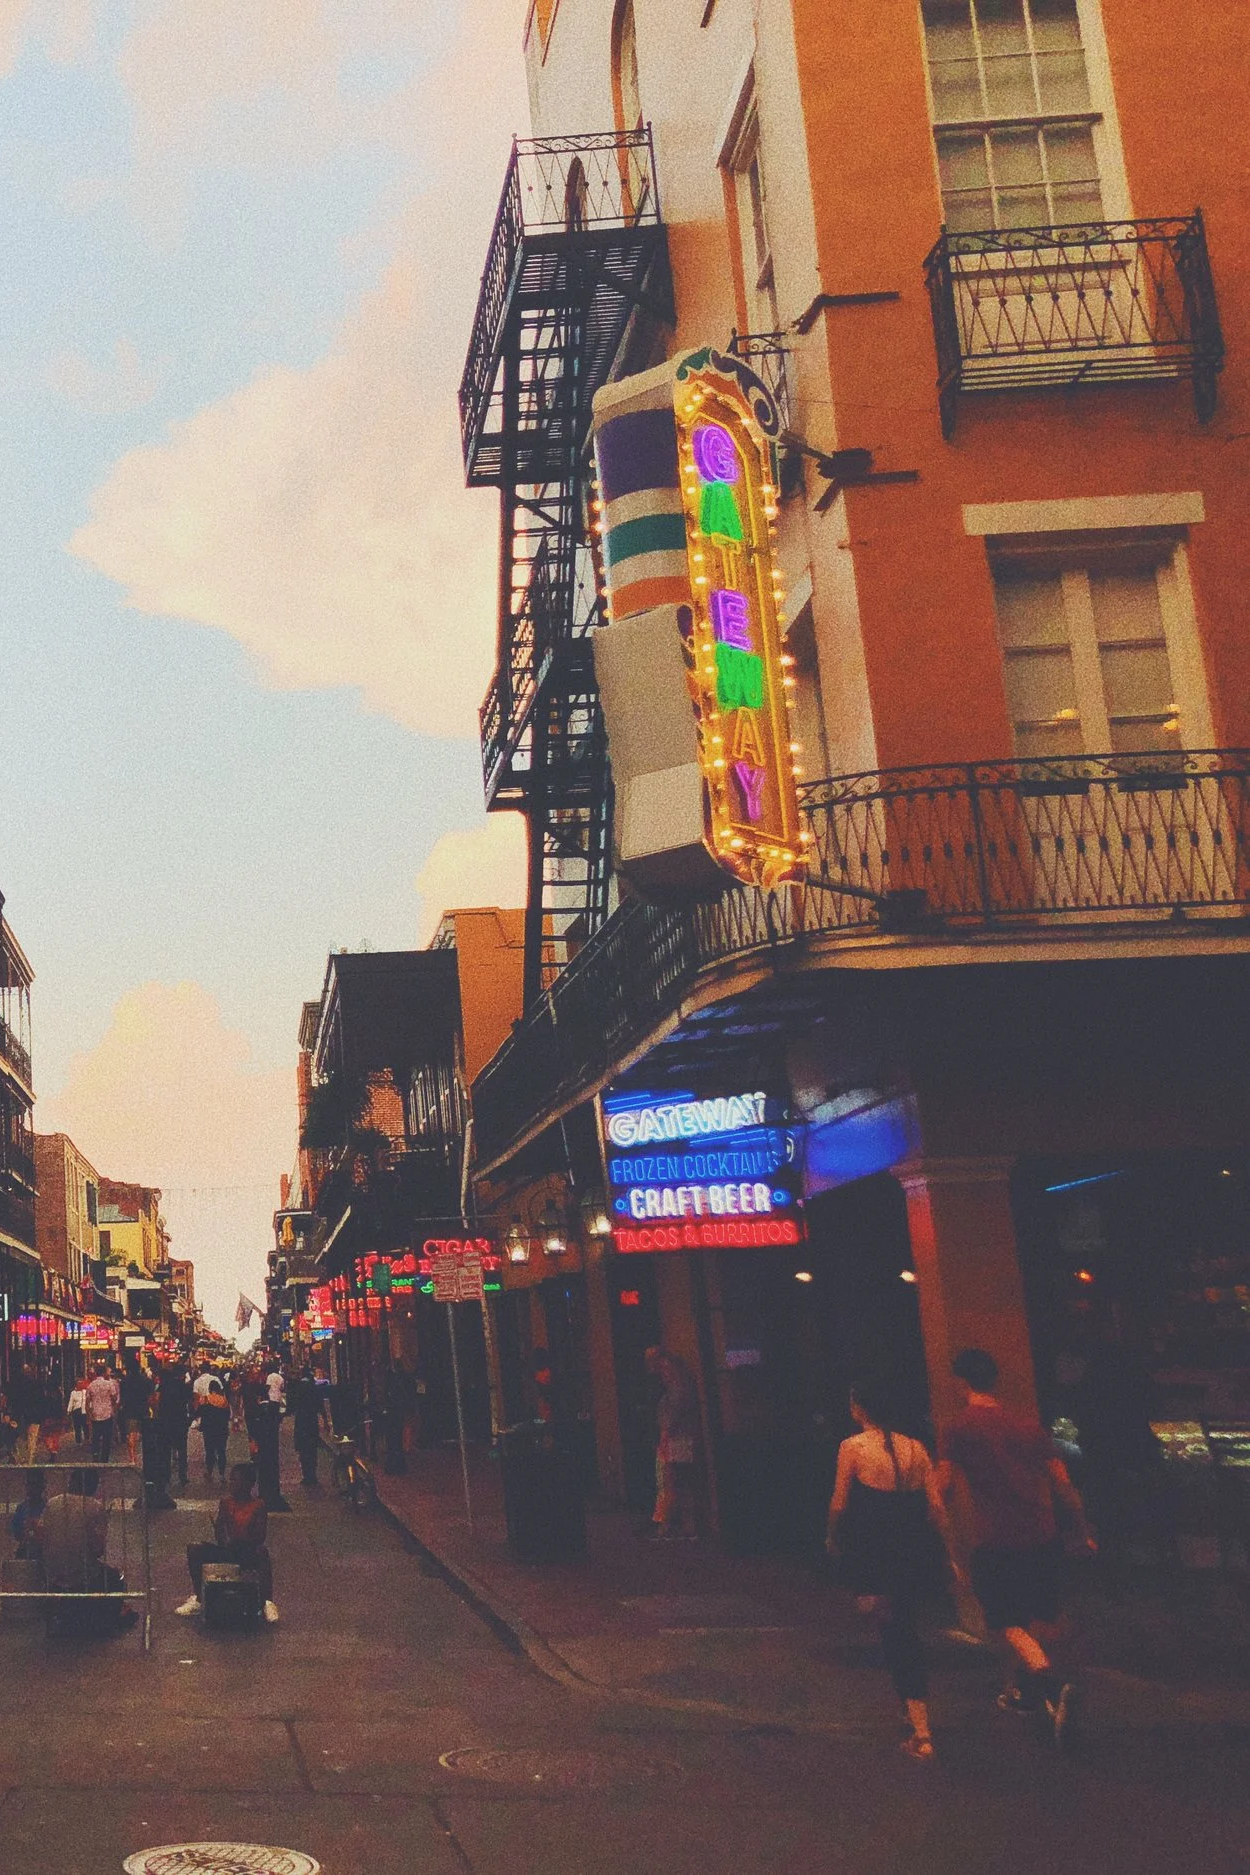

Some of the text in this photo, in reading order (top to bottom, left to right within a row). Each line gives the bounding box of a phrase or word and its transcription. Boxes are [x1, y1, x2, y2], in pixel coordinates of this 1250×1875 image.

[693, 423, 766, 820] GATEWAY
[609, 1092, 767, 1147] GATEWAY
[611, 1151, 778, 1183] FROZEN COCKTAILS
[630, 1183, 771, 1219] CRAFT BEER
[423, 1238, 490, 1256] CIGAR
[614, 1222, 793, 1250] TACOS & BURRITOS
